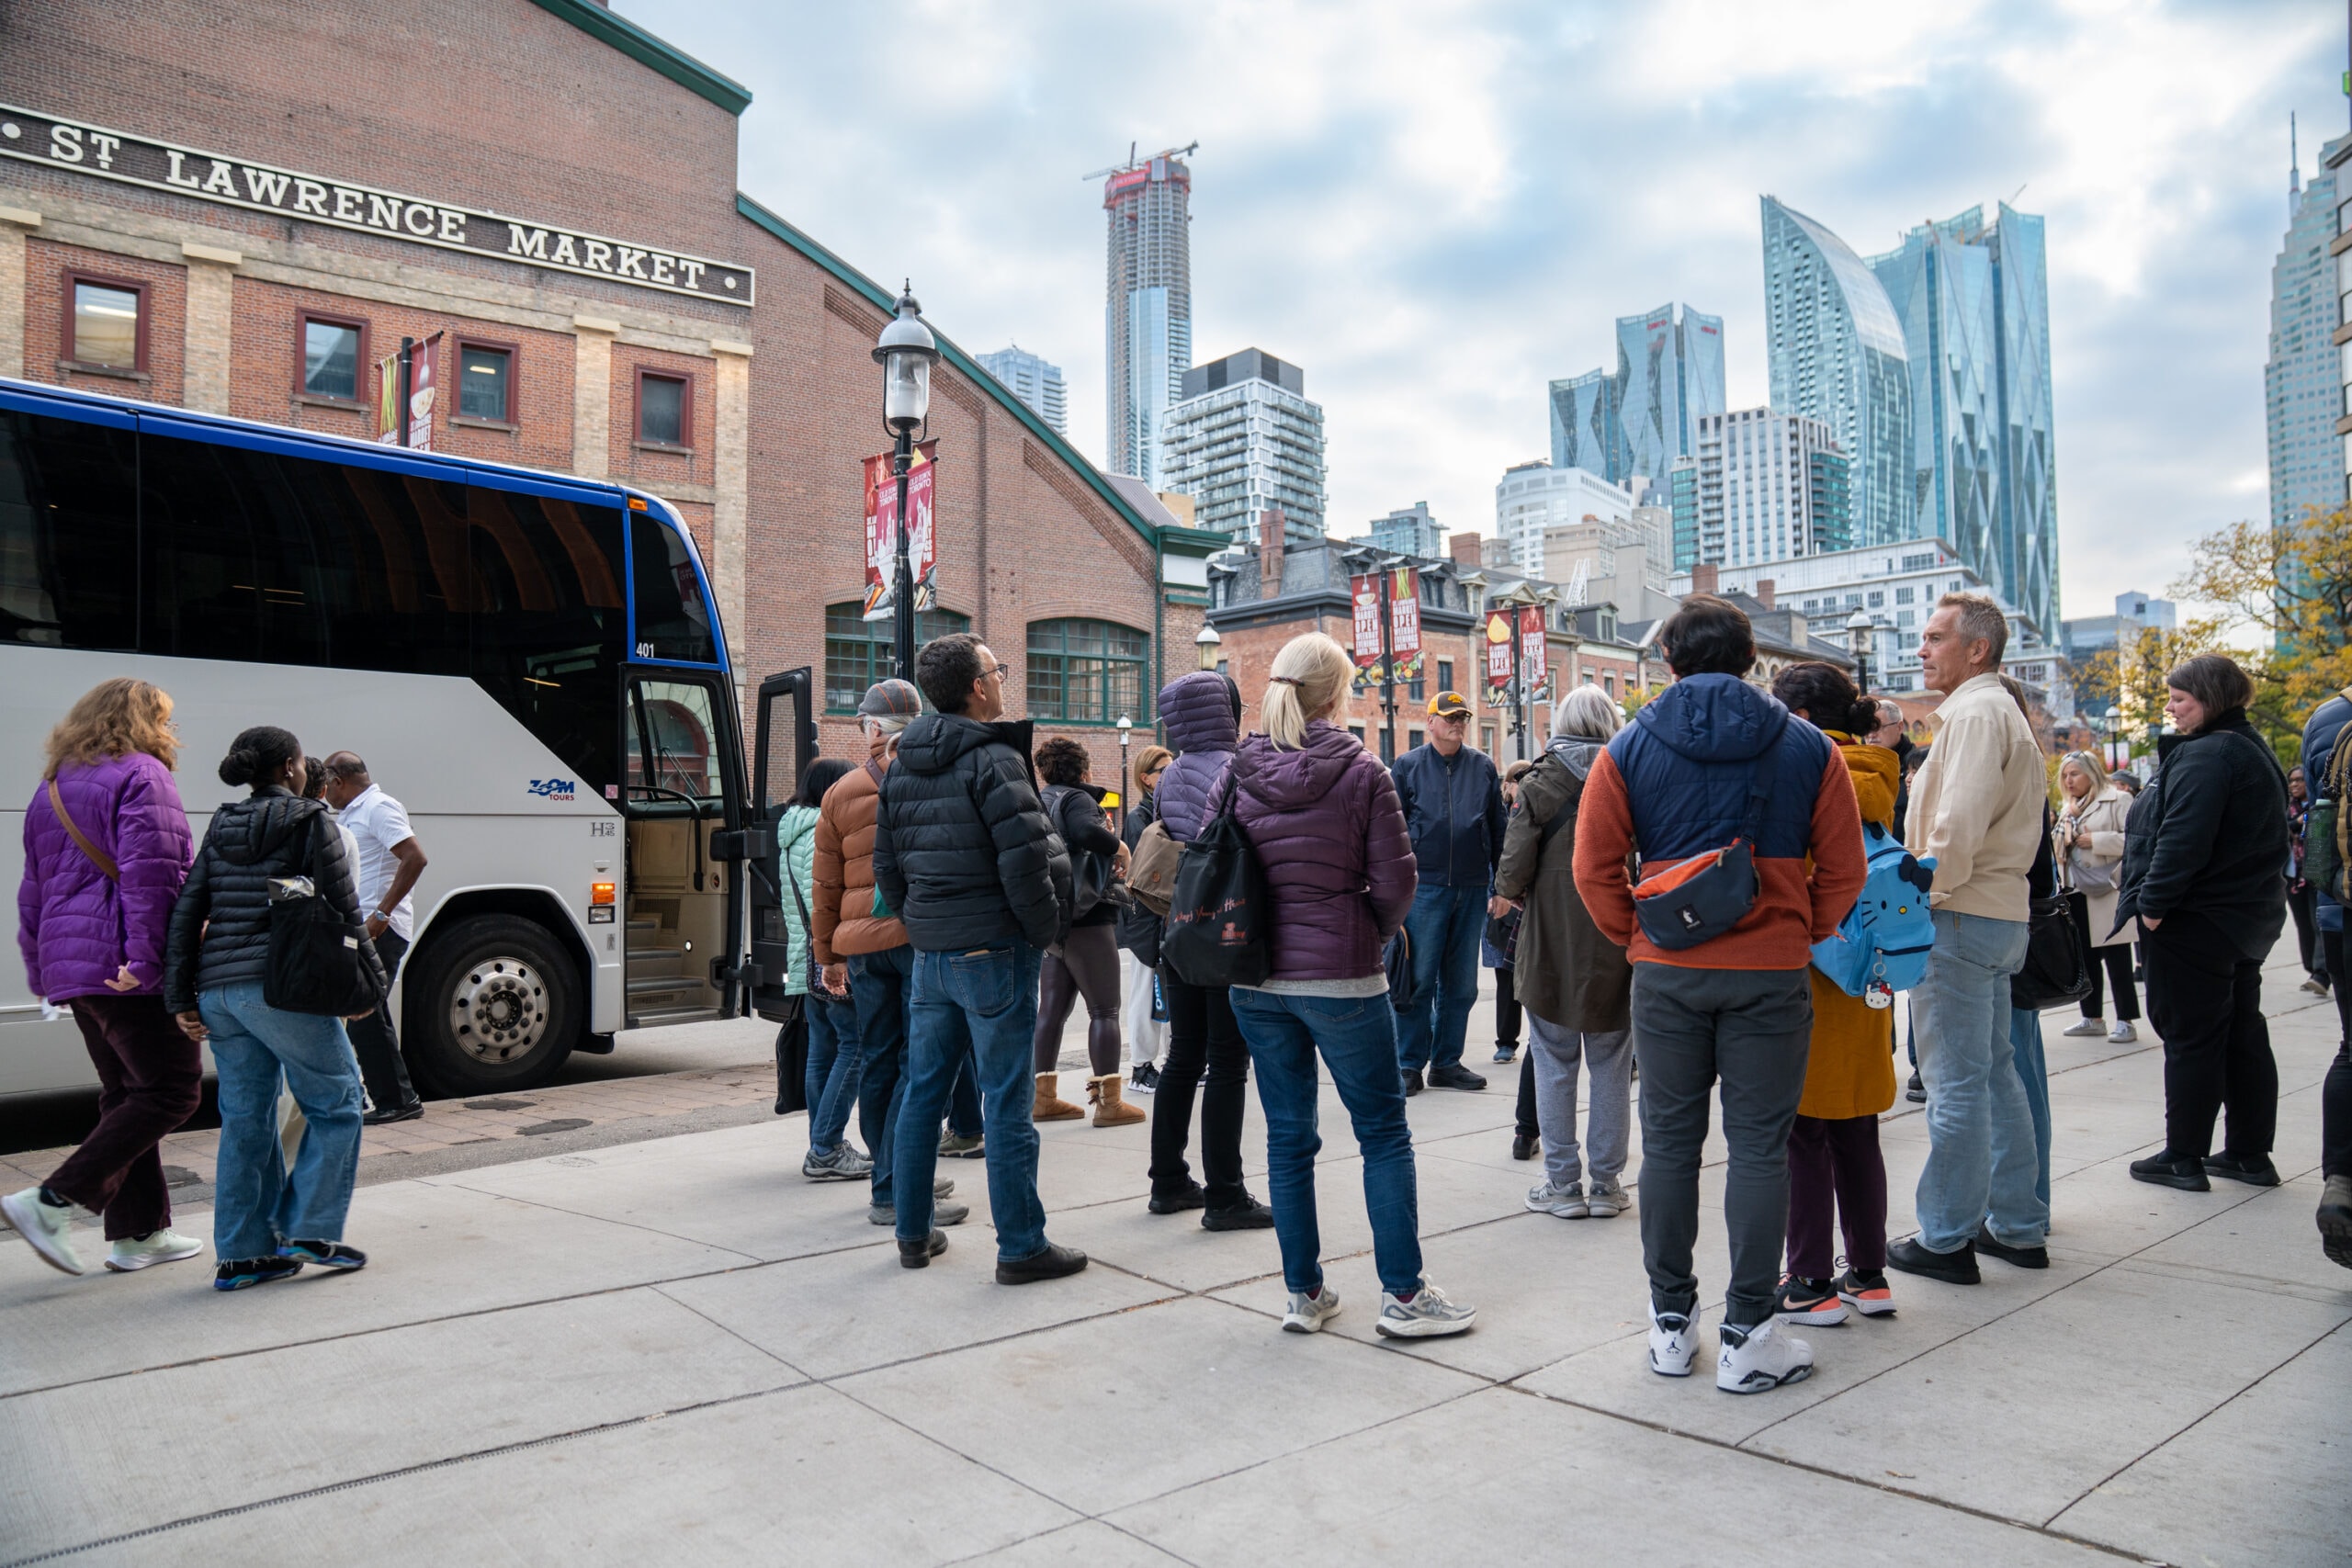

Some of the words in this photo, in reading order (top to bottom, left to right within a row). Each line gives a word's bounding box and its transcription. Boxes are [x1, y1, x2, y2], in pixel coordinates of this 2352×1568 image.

[166, 150, 466, 243] LAWRENCE
[508, 223, 705, 289] MARKET
[909, 479, 932, 494] TORONTO
[1355, 619, 1378, 634] OPEN
[1394, 614, 1417, 628] OPEN
[636, 642, 654, 658] 401
[1489, 658, 1510, 670] OPEN
[527, 779, 574, 796] ZOOM
